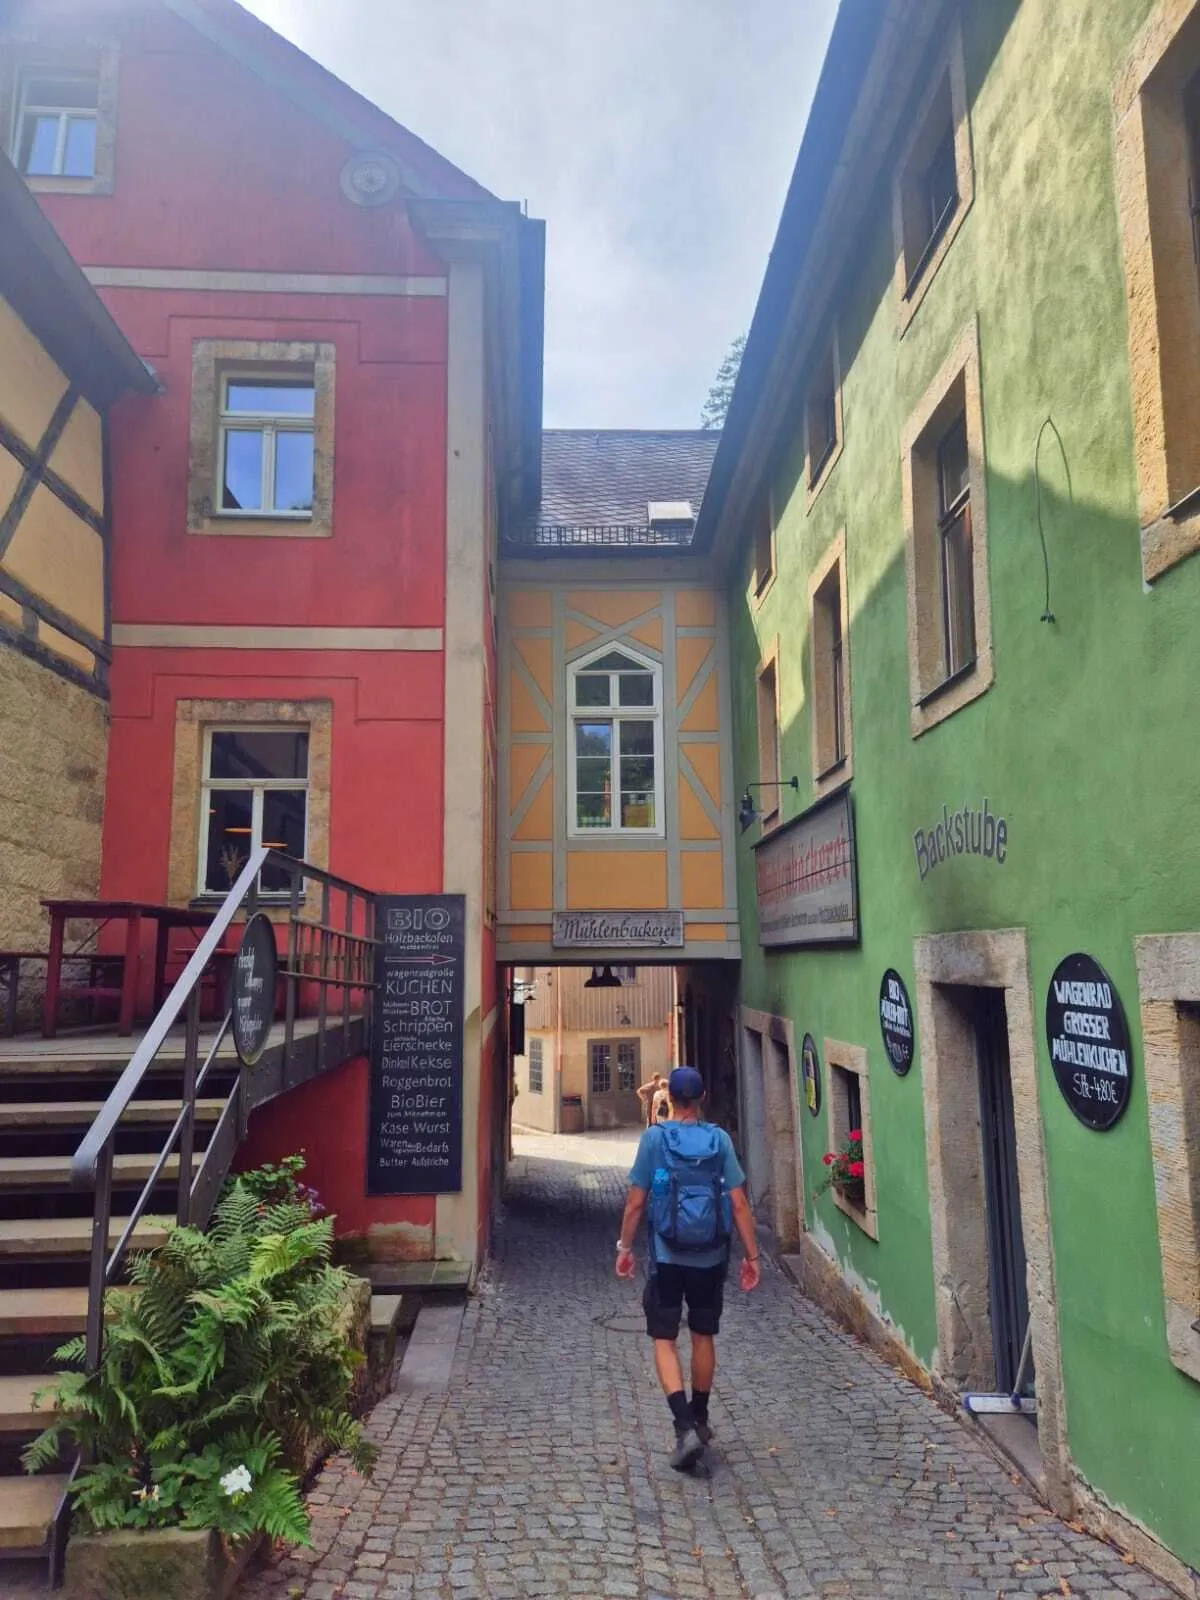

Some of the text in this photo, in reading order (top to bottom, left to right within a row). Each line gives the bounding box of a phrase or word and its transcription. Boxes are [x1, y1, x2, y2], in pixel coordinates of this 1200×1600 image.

[913, 797, 1007, 881] Backstube
[387, 907, 450, 930] BIO
[385, 930, 453, 944] Holzbackofen
[386, 979, 452, 995] KUCHEN
[1054, 980, 1112, 1009] WAGENRAD
[410, 1000, 453, 1016] BROT
[383, 1019, 453, 1035] Schrippen
[1063, 1011, 1111, 1040] GROSSER
[383, 1039, 452, 1052] Eierschecke
[1052, 1034, 1128, 1077] MÜHLENKUCHEN
[382, 1075, 452, 1090] Roggenbrot
[413, 1121, 450, 1133] Wurst
[379, 1156, 407, 1167] Butter
